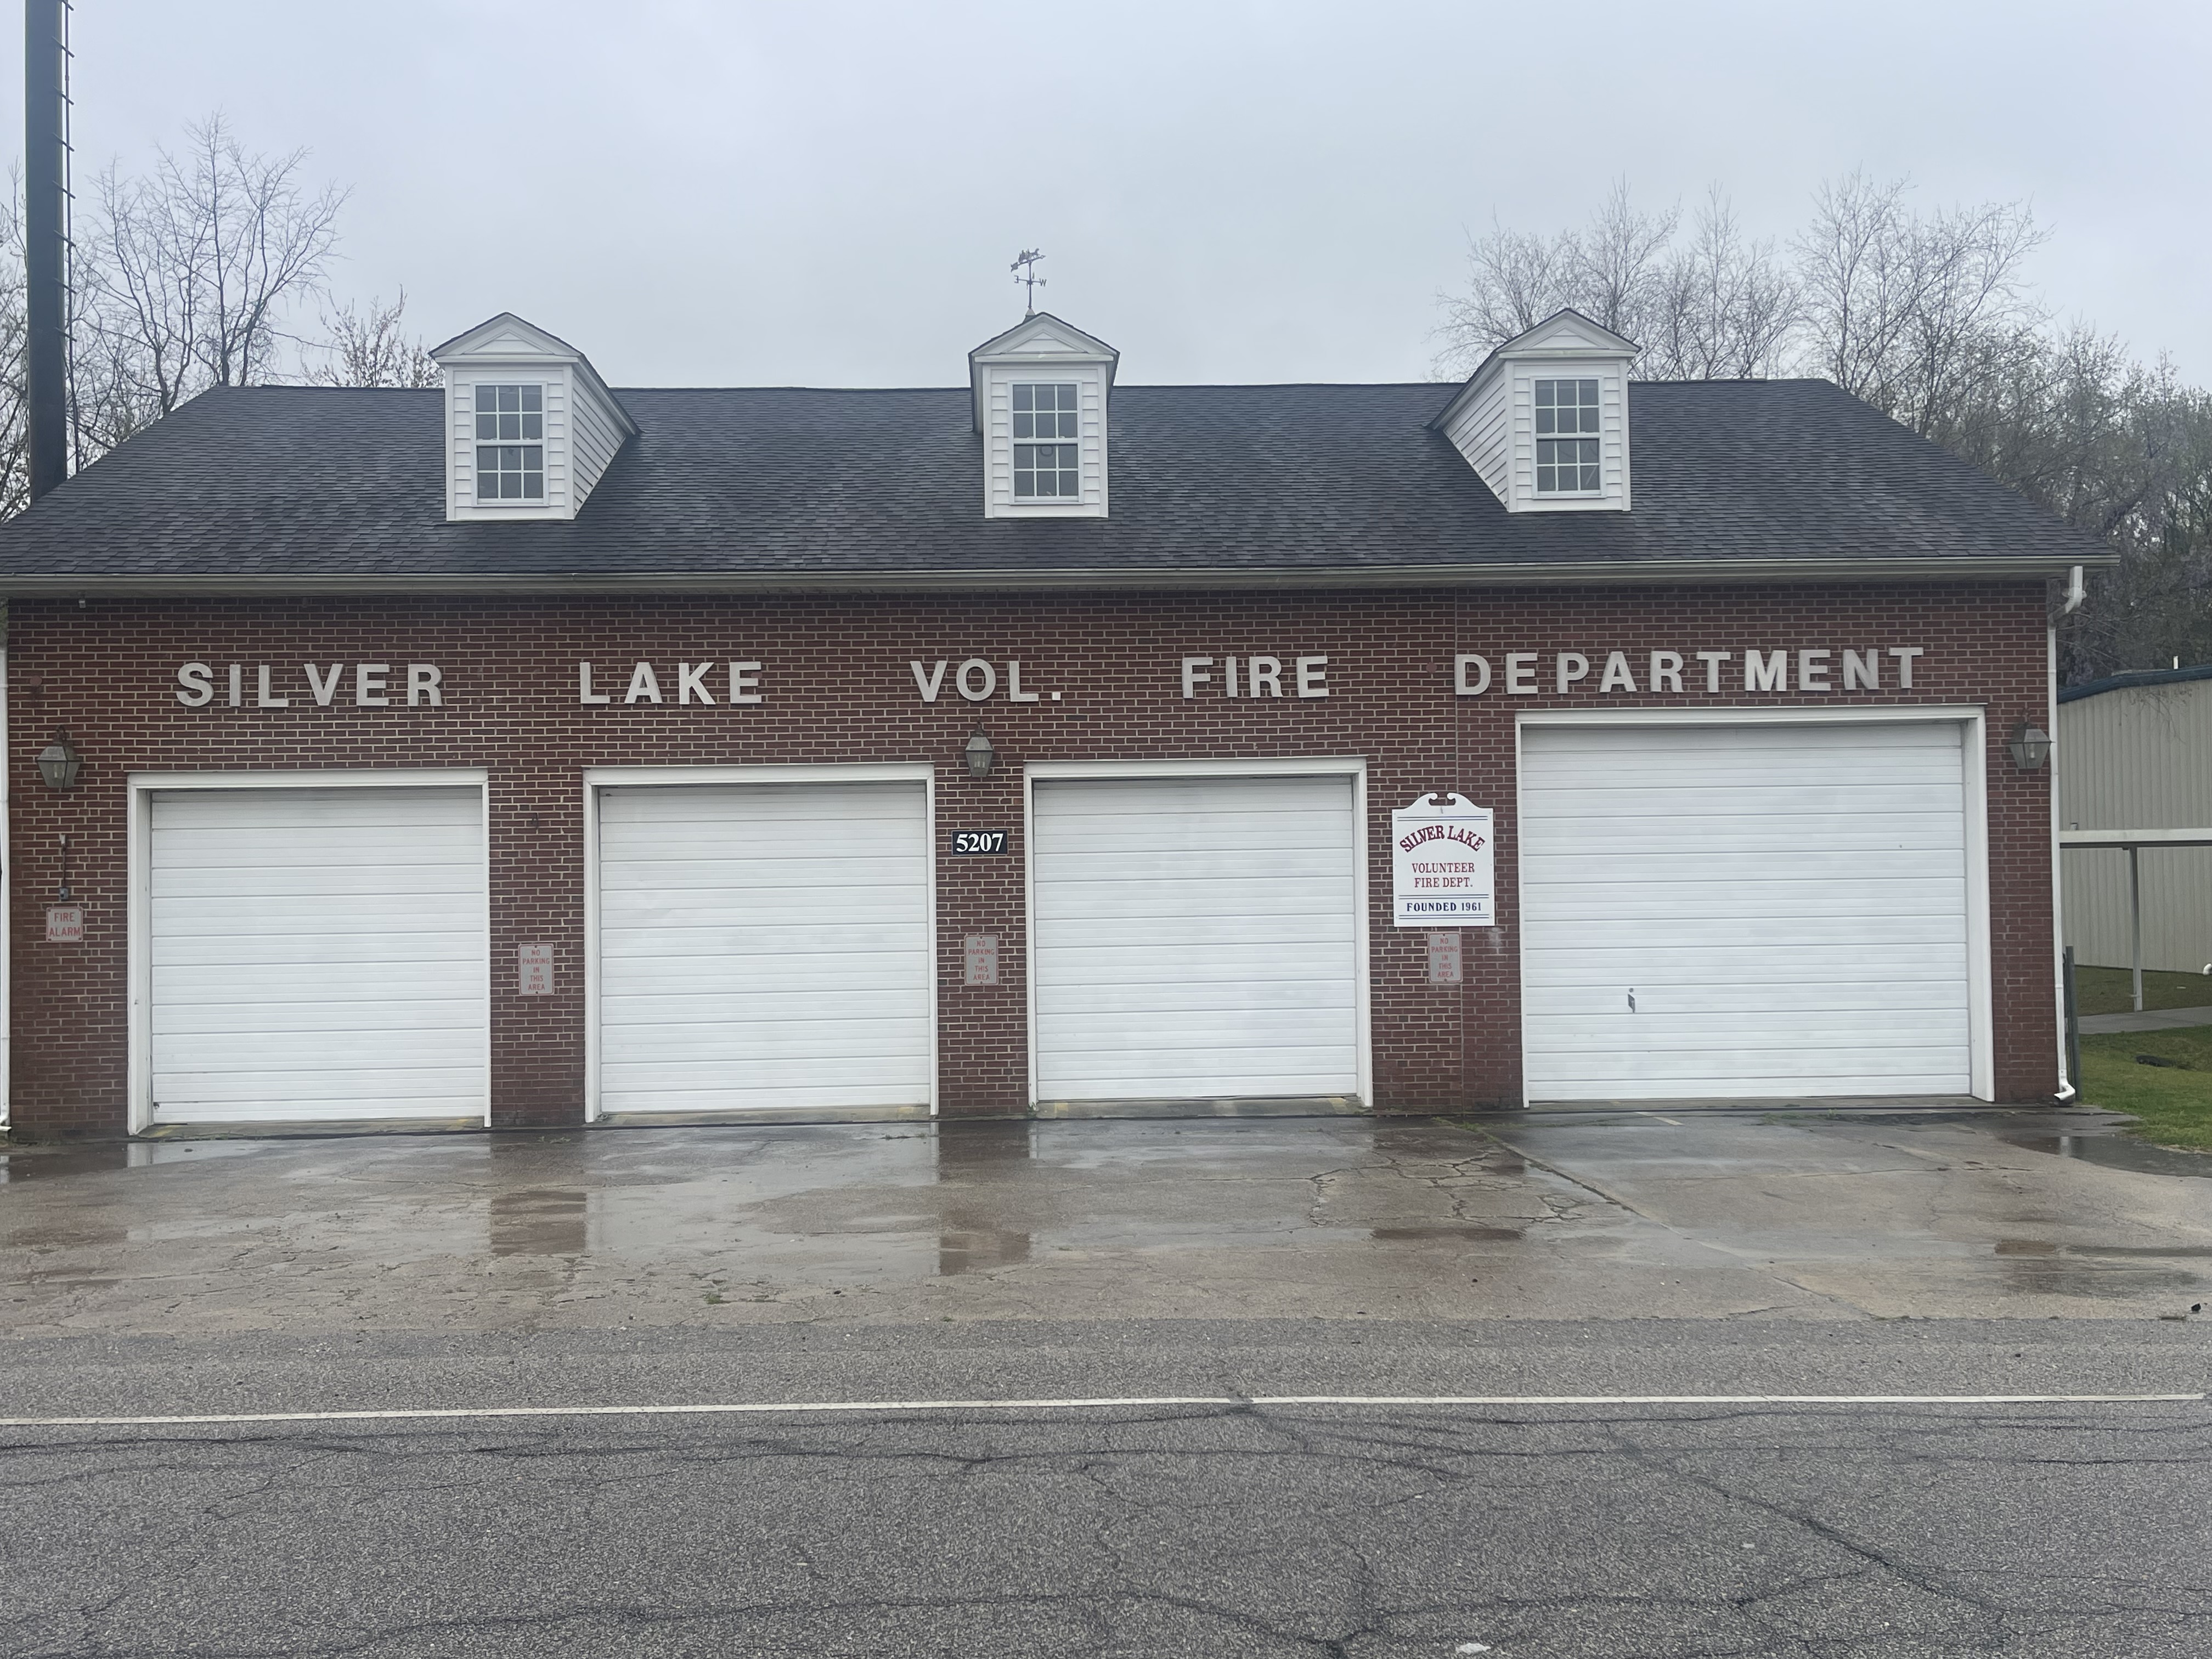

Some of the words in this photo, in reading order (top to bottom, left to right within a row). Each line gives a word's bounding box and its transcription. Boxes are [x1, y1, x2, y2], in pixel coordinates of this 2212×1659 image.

[1039, 278, 1047, 287] W
[176, 662, 443, 707] SILVER
[579, 661, 763, 705] LAKE
[911, 658, 1061, 703] VOL.
[1182, 656, 1330, 699] FIRE
[1454, 647, 1924, 696] DEPARTMENT
[956, 833, 1003, 853] 5207
[1400, 825, 1444, 853] SILVER
[1447, 825, 1486, 851] LAKE
[1412, 862, 1475, 873] VOLUNTEER
[1414, 877, 1440, 888] FIRE
[1442, 877, 1473, 888] DEPT.
[1407, 902, 1457, 912] FOUNDED
[1461, 902, 1482, 911] 1961
[54, 912, 75, 922] FIRE
[49, 927, 81, 937] ALARM
